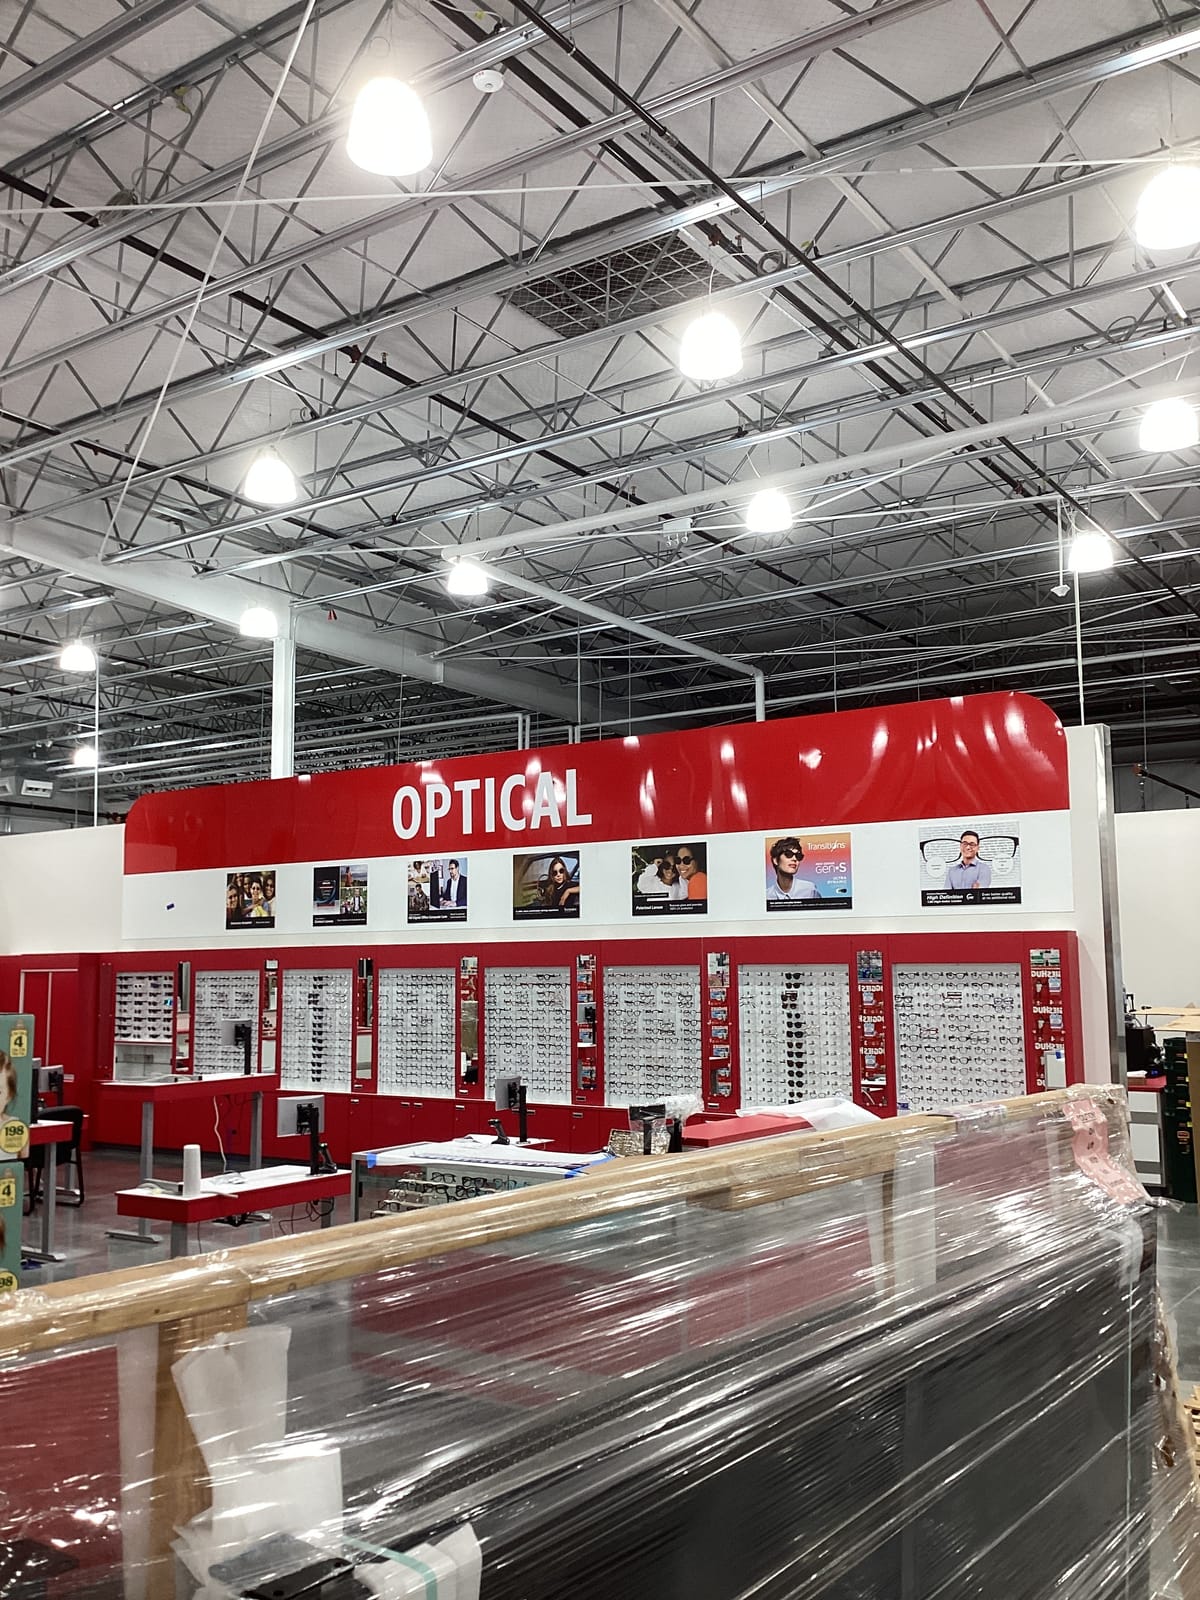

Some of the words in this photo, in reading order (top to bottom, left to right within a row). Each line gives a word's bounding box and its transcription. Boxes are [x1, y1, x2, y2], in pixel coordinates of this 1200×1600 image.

[392, 768, 592, 840] OPTICAL
[14, 1036, 23, 1048] 4
[5, 1125, 24, 1137] 198
[2, 1184, 11, 1197] 4
